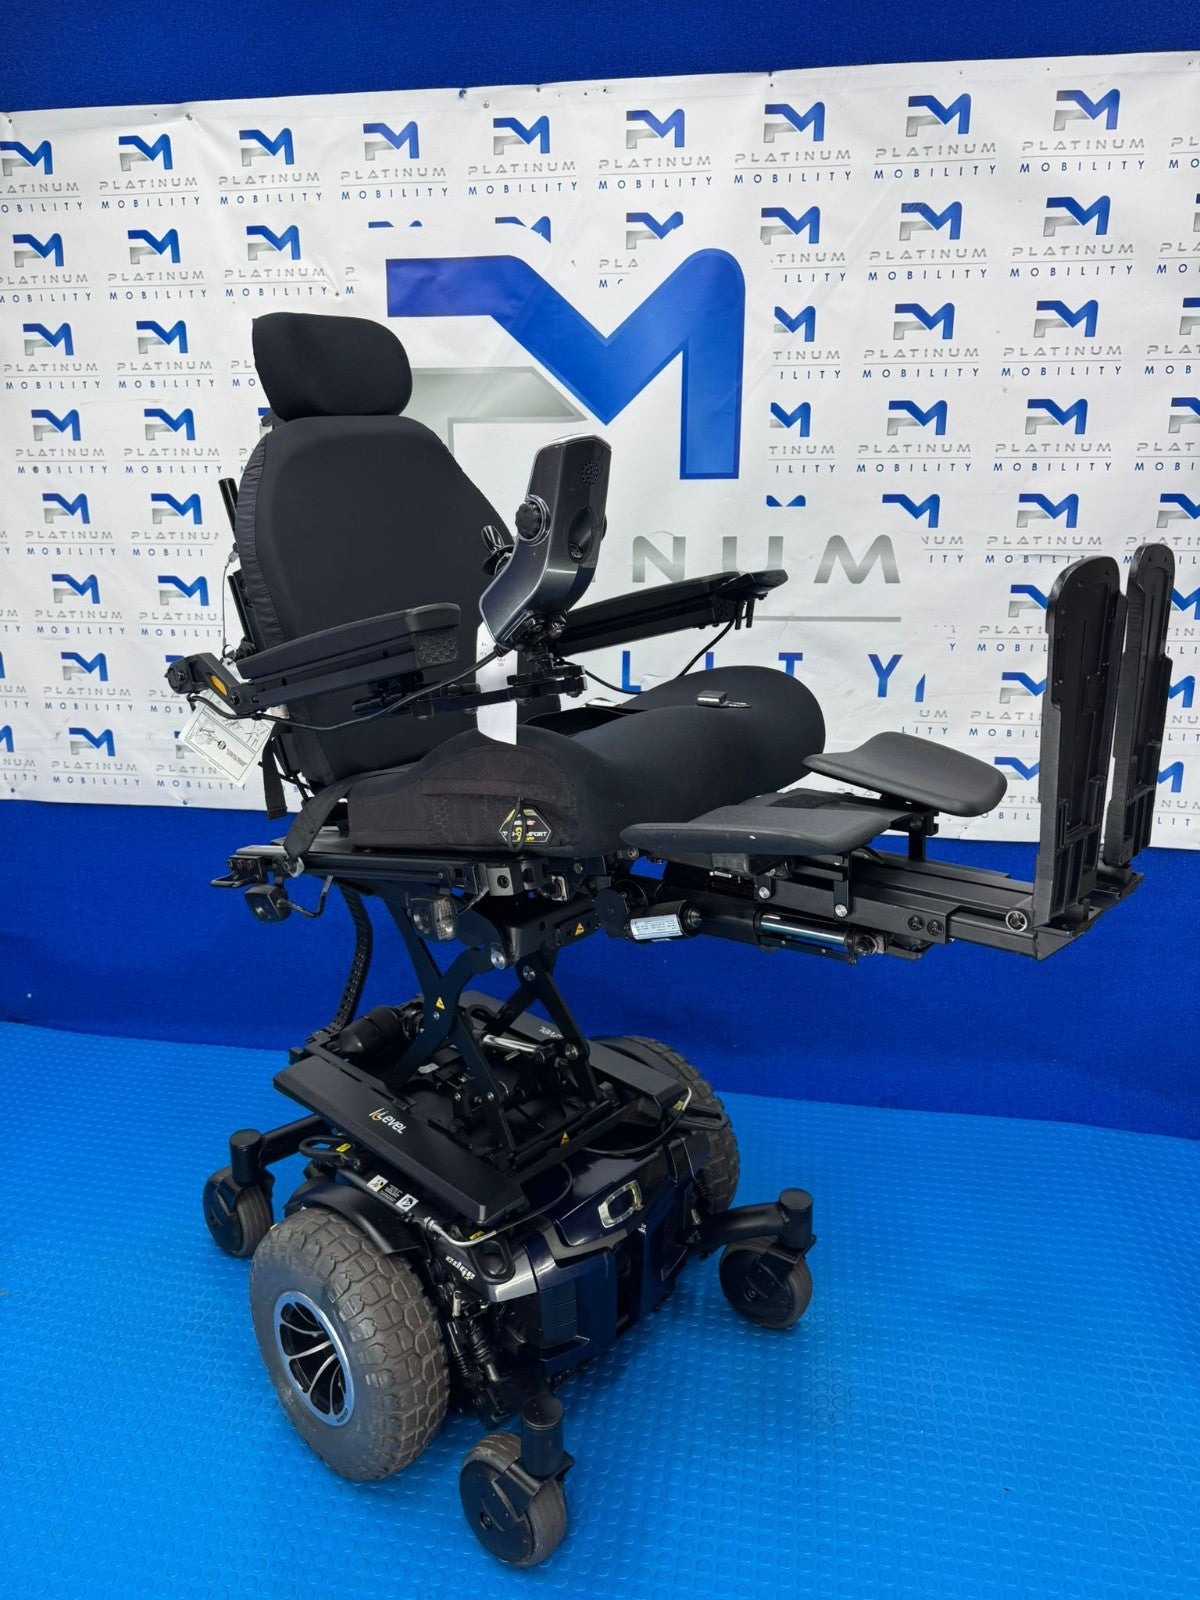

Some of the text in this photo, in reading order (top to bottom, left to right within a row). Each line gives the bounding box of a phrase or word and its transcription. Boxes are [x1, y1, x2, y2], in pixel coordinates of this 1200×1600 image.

[876, 142, 996, 158] PLATINUM
[1022, 138, 1144, 151] PLATINUM
[735, 150, 850, 163] PLATINUM
[468, 161, 575, 175] PLATINUM
[599, 156, 711, 169] PLATINUM
[1020, 160, 1144, 173] MOBILITY
[341, 167, 446, 180] PLATINUM
[734, 171, 851, 184] MOBILITY
[874, 165, 996, 179] MOBILITY
[98, 177, 197, 190] PLATINUM
[219, 172, 320, 185] PLATINUM
[599, 176, 712, 190] MOBILITY
[0, 180, 79, 194] ATINUM
[469, 181, 577, 195] MOBILITY
[220, 192, 322, 205] MOBILITY
[342, 187, 447, 200] MOBILITY
[0, 202, 82, 214] OBILITY
[101, 197, 199, 209] MOBILITY
[869, 248, 986, 260] PLATINUM
[1012, 244, 1134, 256] PLATINUM
[108, 271, 204, 281] PLATINUM
[225, 267, 325, 279] PLATINUM
[868, 269, 987, 281] MOBILITY
[1009, 265, 1133, 277] MOBILITY
[110, 288, 206, 300] MOBILITY
[226, 286, 326, 297] MOBILITY
[864, 348, 979, 359] PLATINUM
[1003, 346, 1122, 356] PLATINUM
[4, 363, 98, 372] PLATINUM
[117, 361, 212, 371] PLATINUM
[862, 368, 979, 378] MOBILITY
[1001, 366, 1121, 378] MOBILITY
[6, 381, 100, 390] MOBILITY
[119, 379, 214, 388] MOBILITY
[15, 448, 104, 457] PLATINUM
[124, 448, 219, 456] PLATINUM
[858, 444, 971, 453] PLATINUM
[995, 443, 1111, 452] PLATINUM
[125, 465, 222, 474] MOBILITY
[856, 463, 971, 473] MOBILITY
[993, 462, 1111, 471] MOBILITY
[25, 531, 112, 539] PLATINUM
[987, 536, 1102, 545] PLATINUM
[27, 547, 116, 555] MOBILITY
[35, 610, 122, 619] PLATINUM
[37, 626, 124, 635] MOBILITY
[44, 687, 131, 696] PLATINUM
[45, 702, 133, 711] MOBILITY
[52, 761, 137, 771] PLATINUM
[53, 776, 139, 786] MOBILITY
